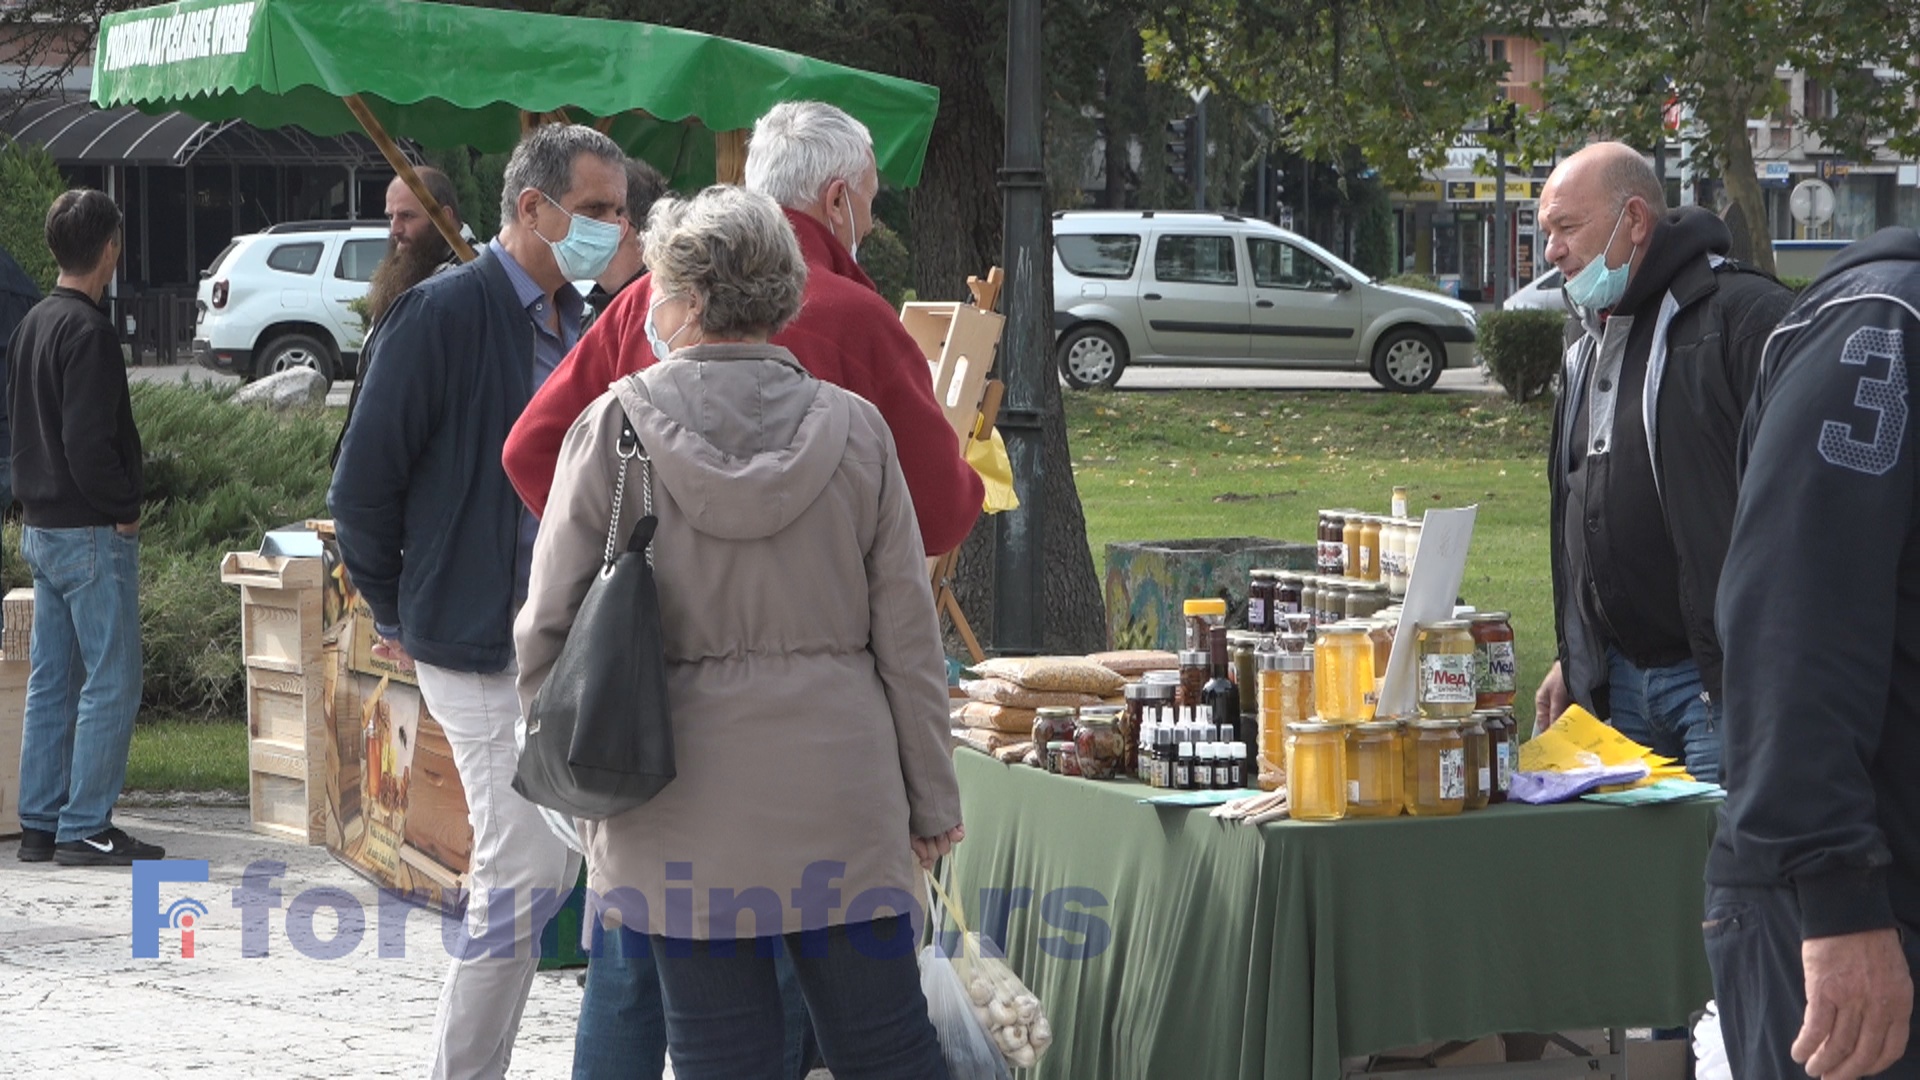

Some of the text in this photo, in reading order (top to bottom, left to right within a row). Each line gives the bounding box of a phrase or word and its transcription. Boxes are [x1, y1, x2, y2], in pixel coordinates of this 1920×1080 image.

[211, 1, 255, 55] OPREME
[1817, 325, 1909, 476] 3
[1433, 669, 1467, 687] Мед
[1489, 661, 1514, 675] Мед
